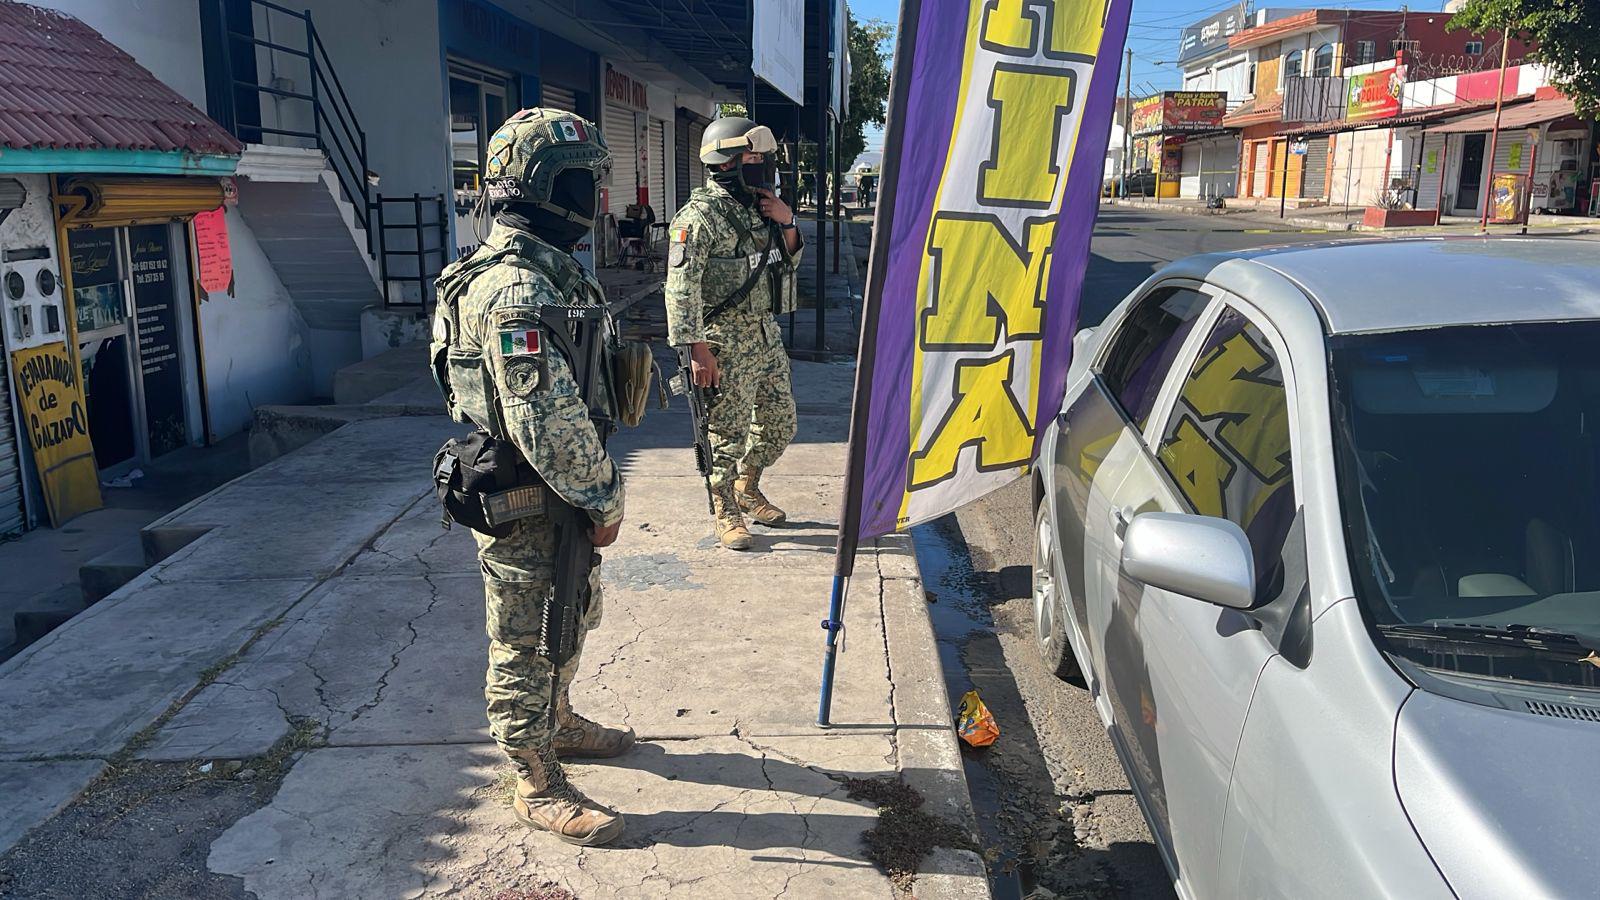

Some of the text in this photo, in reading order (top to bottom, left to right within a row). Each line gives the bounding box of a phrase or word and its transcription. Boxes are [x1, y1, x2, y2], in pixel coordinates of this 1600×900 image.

[1177, 98, 1214, 107] PATRIA
[748, 248, 783, 270] EJITO
[39, 384, 58, 412] de
[30, 400, 87, 450] CALZADO
